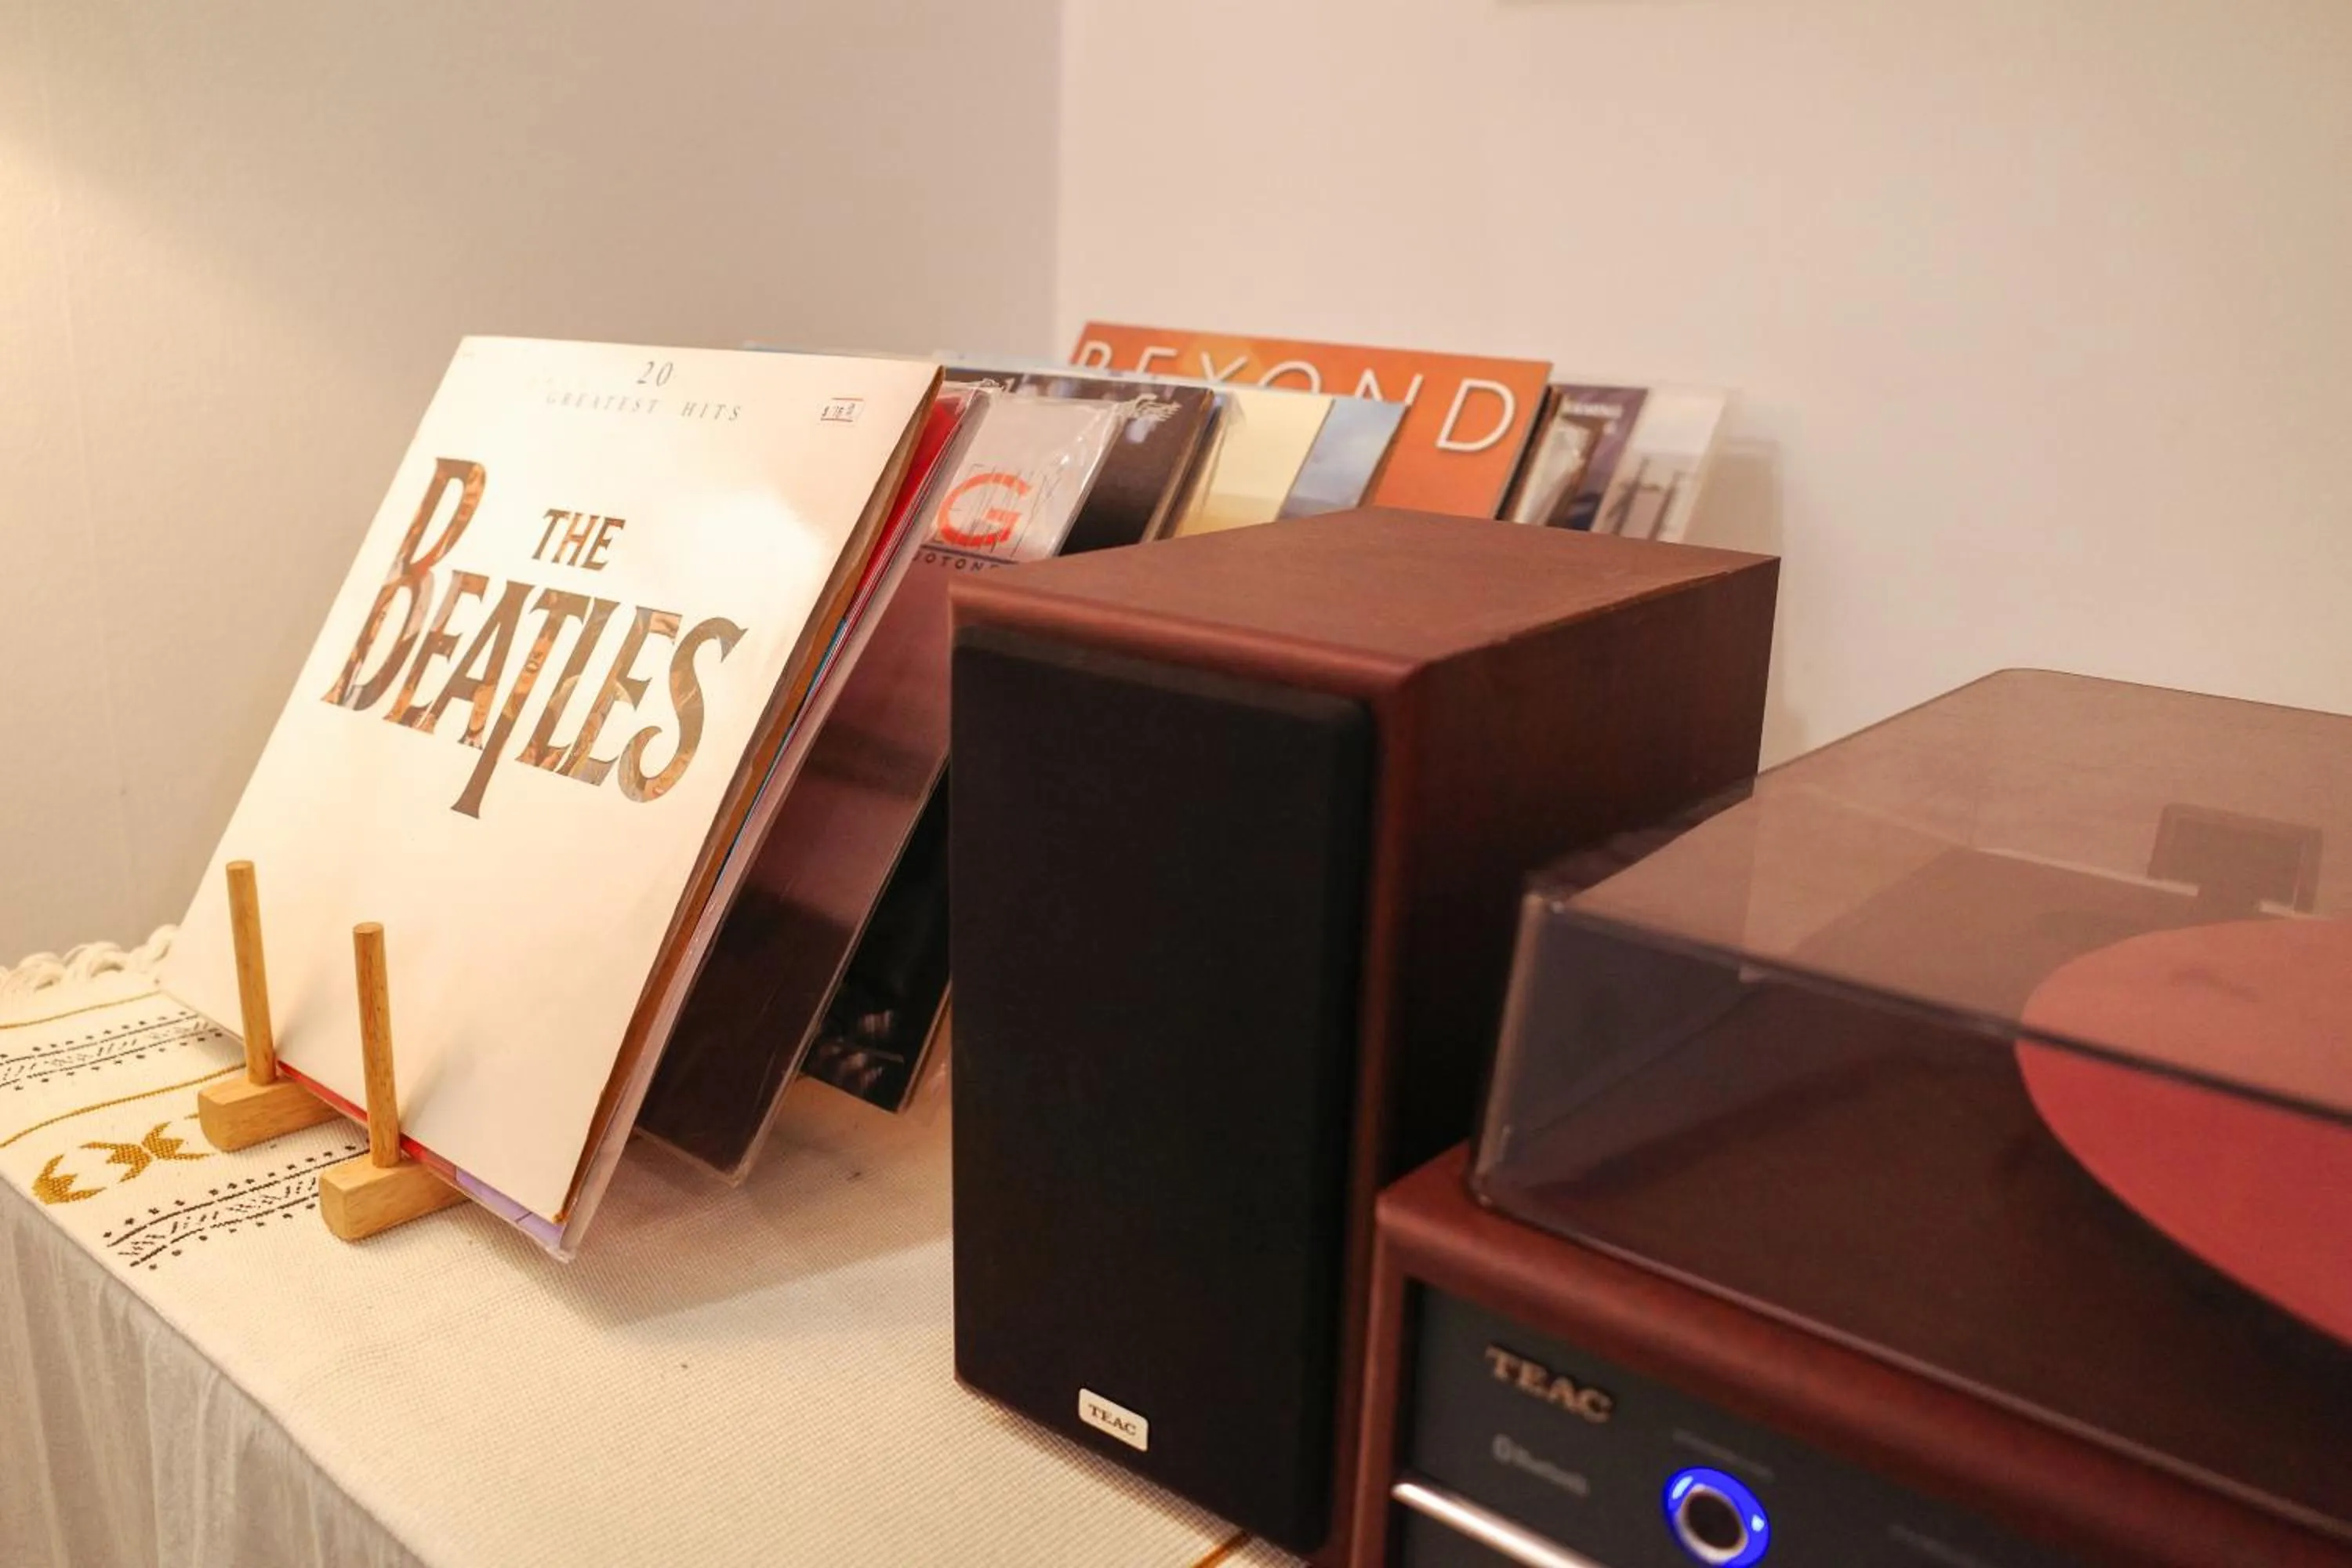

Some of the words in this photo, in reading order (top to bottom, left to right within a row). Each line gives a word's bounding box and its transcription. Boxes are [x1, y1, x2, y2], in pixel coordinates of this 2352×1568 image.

[636, 360, 674, 387] 20
[681, 401, 742, 421] HITS
[532, 508, 626, 571] THE
[913, 550, 1000, 572] OTON
[321, 457, 749, 819] BEATLES
[1485, 1345, 1613, 1423] TEAC
[1088, 1403, 1136, 1436] TEAC
